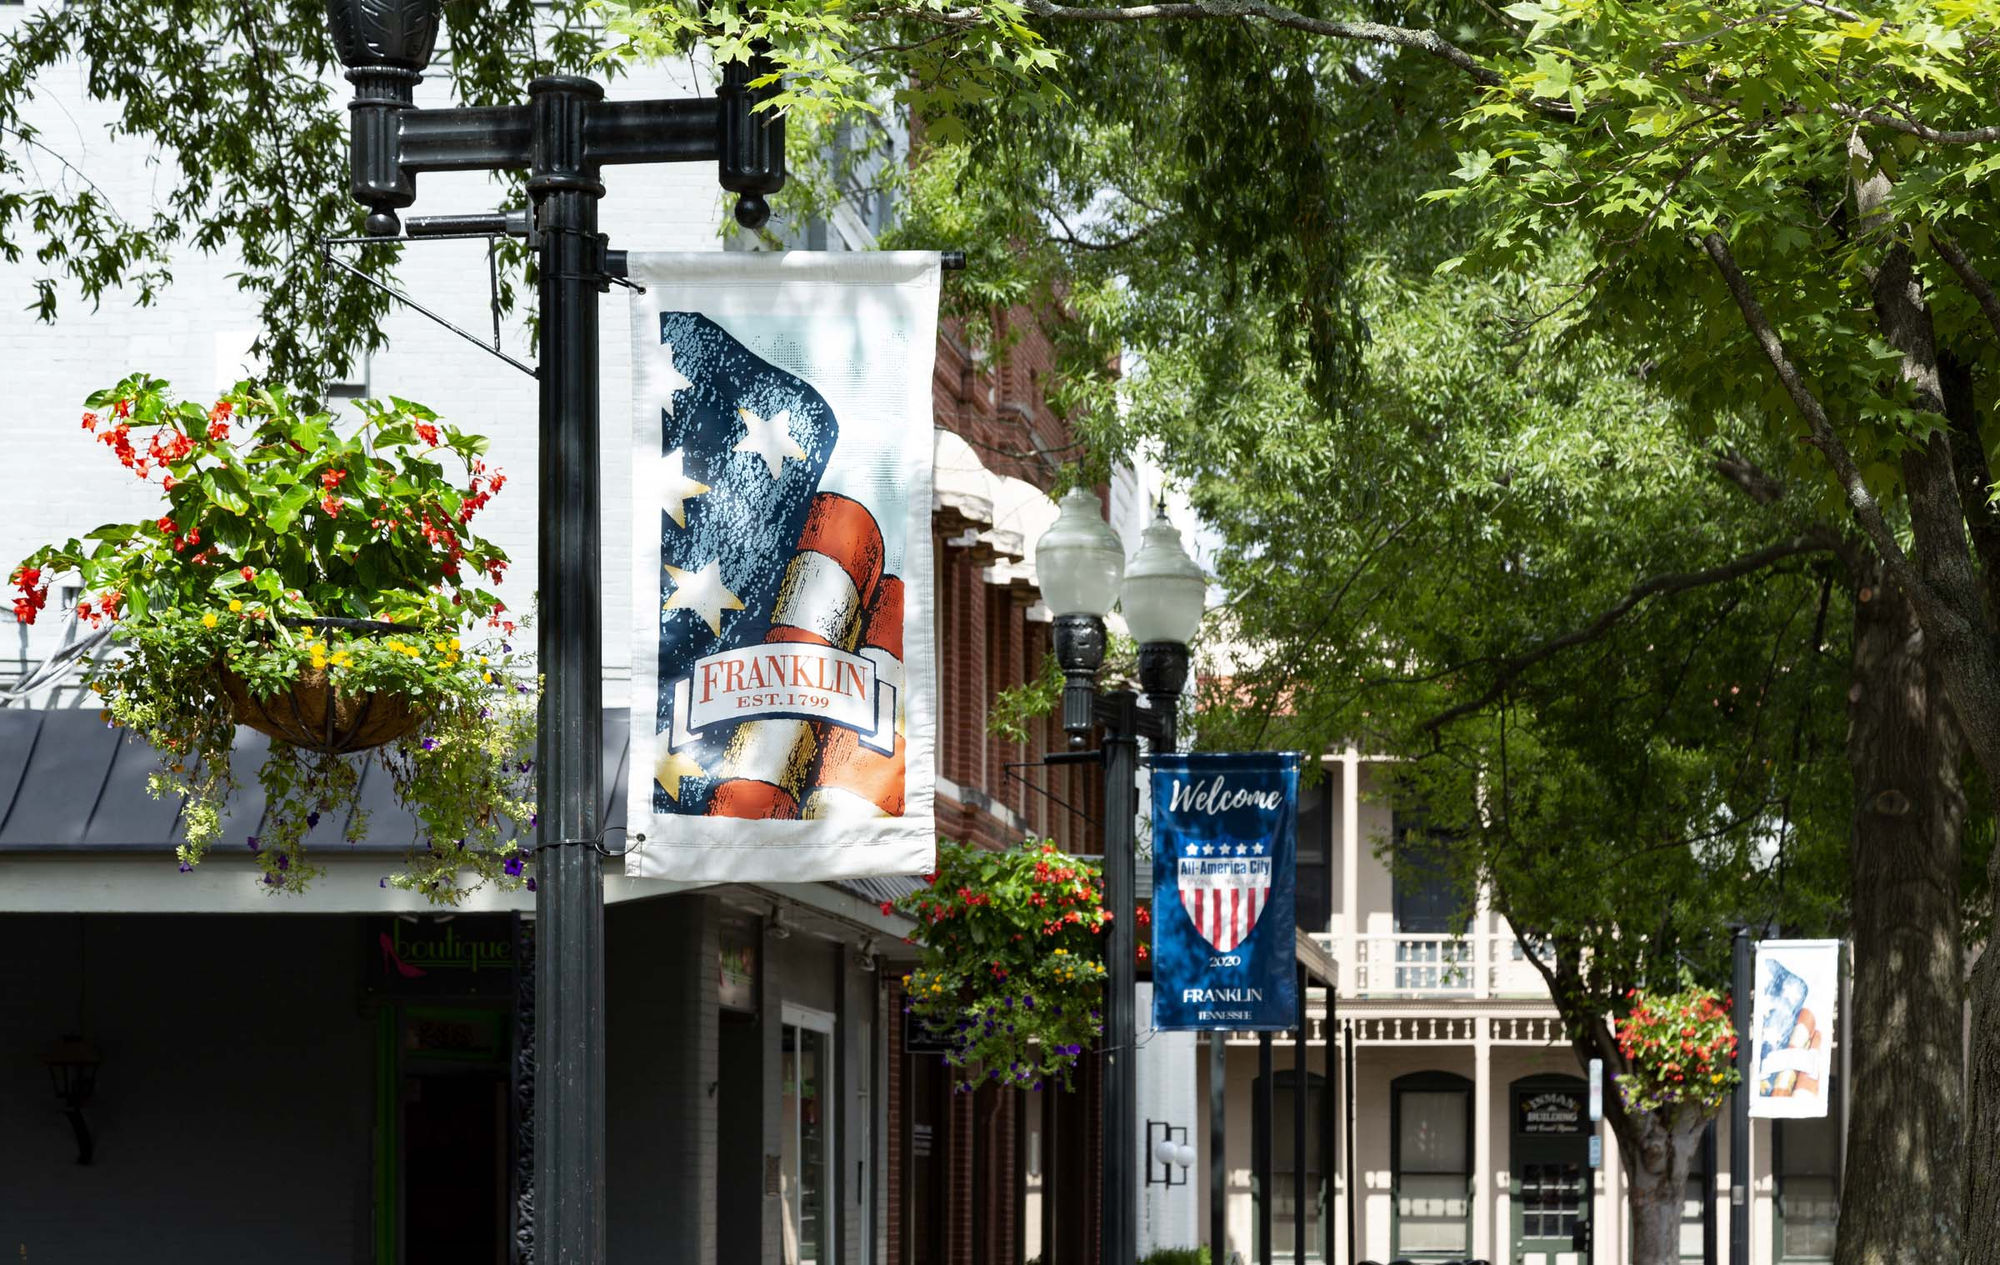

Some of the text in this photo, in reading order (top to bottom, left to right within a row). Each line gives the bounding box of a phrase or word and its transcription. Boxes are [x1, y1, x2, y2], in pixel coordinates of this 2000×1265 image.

[699, 655, 868, 704] FRANKLIN
[1169, 775, 1282, 816] Welcome
[1180, 860, 1270, 876] All-America City
[393, 916, 512, 973] boutique
[1209, 955, 1242, 968] 2020
[1183, 987, 1263, 1003] FRANKLIN
[1198, 1010, 1252, 1020] TENNESSEE
